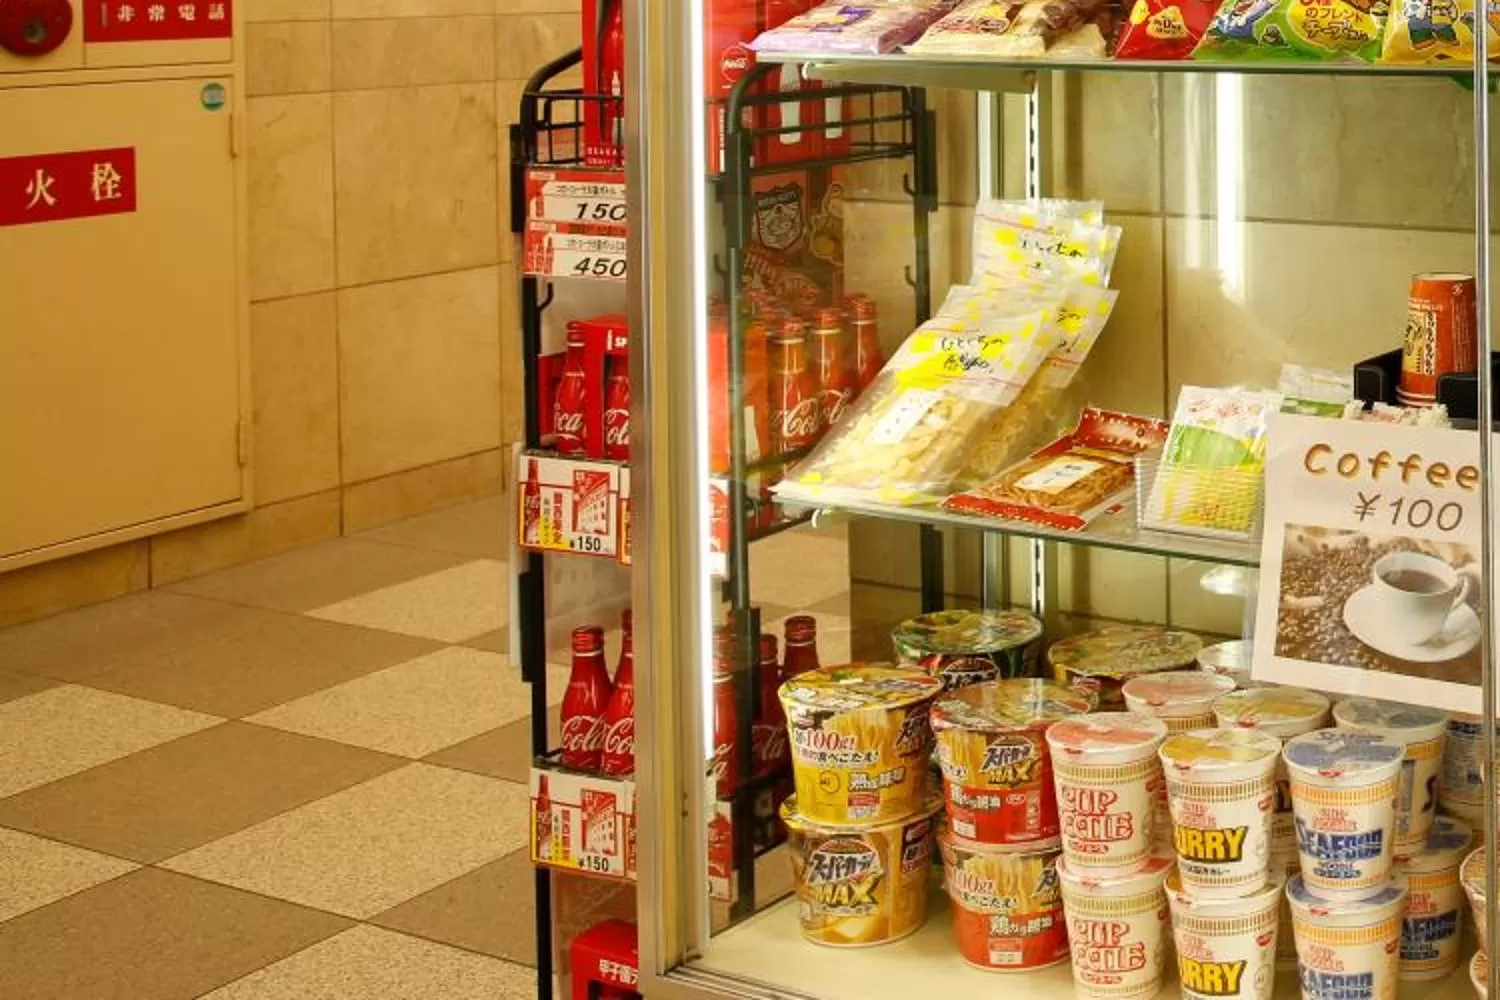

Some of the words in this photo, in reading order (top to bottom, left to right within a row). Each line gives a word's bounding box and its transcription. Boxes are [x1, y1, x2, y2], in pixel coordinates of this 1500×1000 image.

[117, 3, 225, 23] 非常電話
[25, 161, 123, 211] 火栓
[576, 202, 627, 221] 150
[573, 257, 627, 277] 450
[1303, 441, 1481, 491] Coffee
[1353, 490, 1464, 532] ¥100
[1175, 825, 1249, 863] URRY
